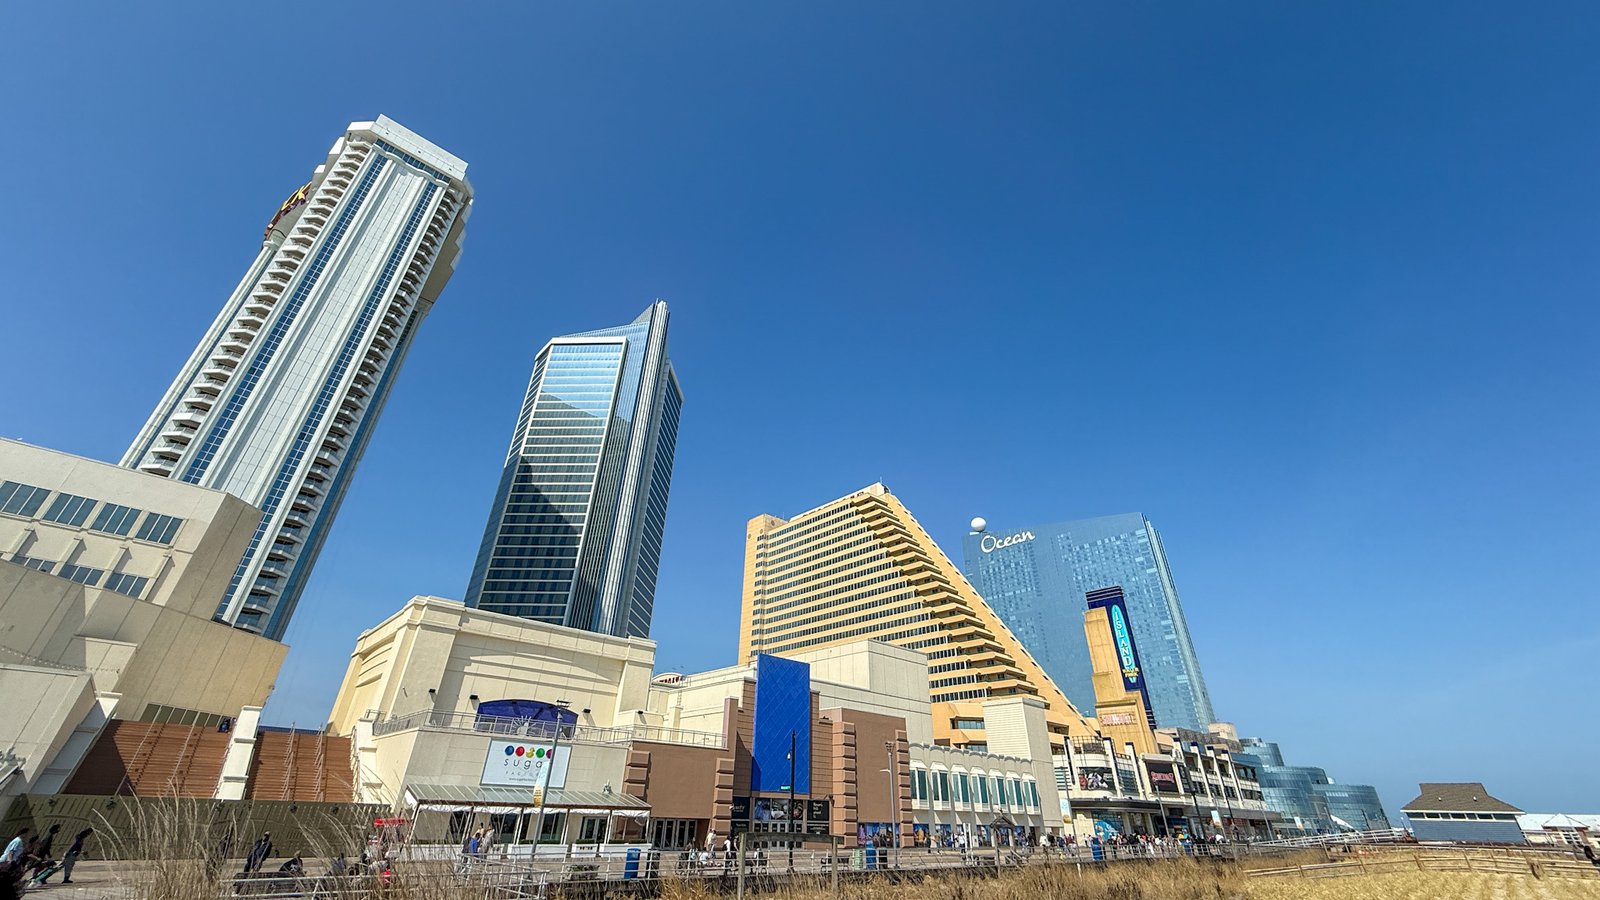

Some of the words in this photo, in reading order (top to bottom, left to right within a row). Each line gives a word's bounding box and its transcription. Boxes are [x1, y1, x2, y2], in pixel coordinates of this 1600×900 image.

[981, 531, 1036, 553] Ocean
[1114, 611, 1133, 667] ISLAND
[503, 758, 543, 770] suga
